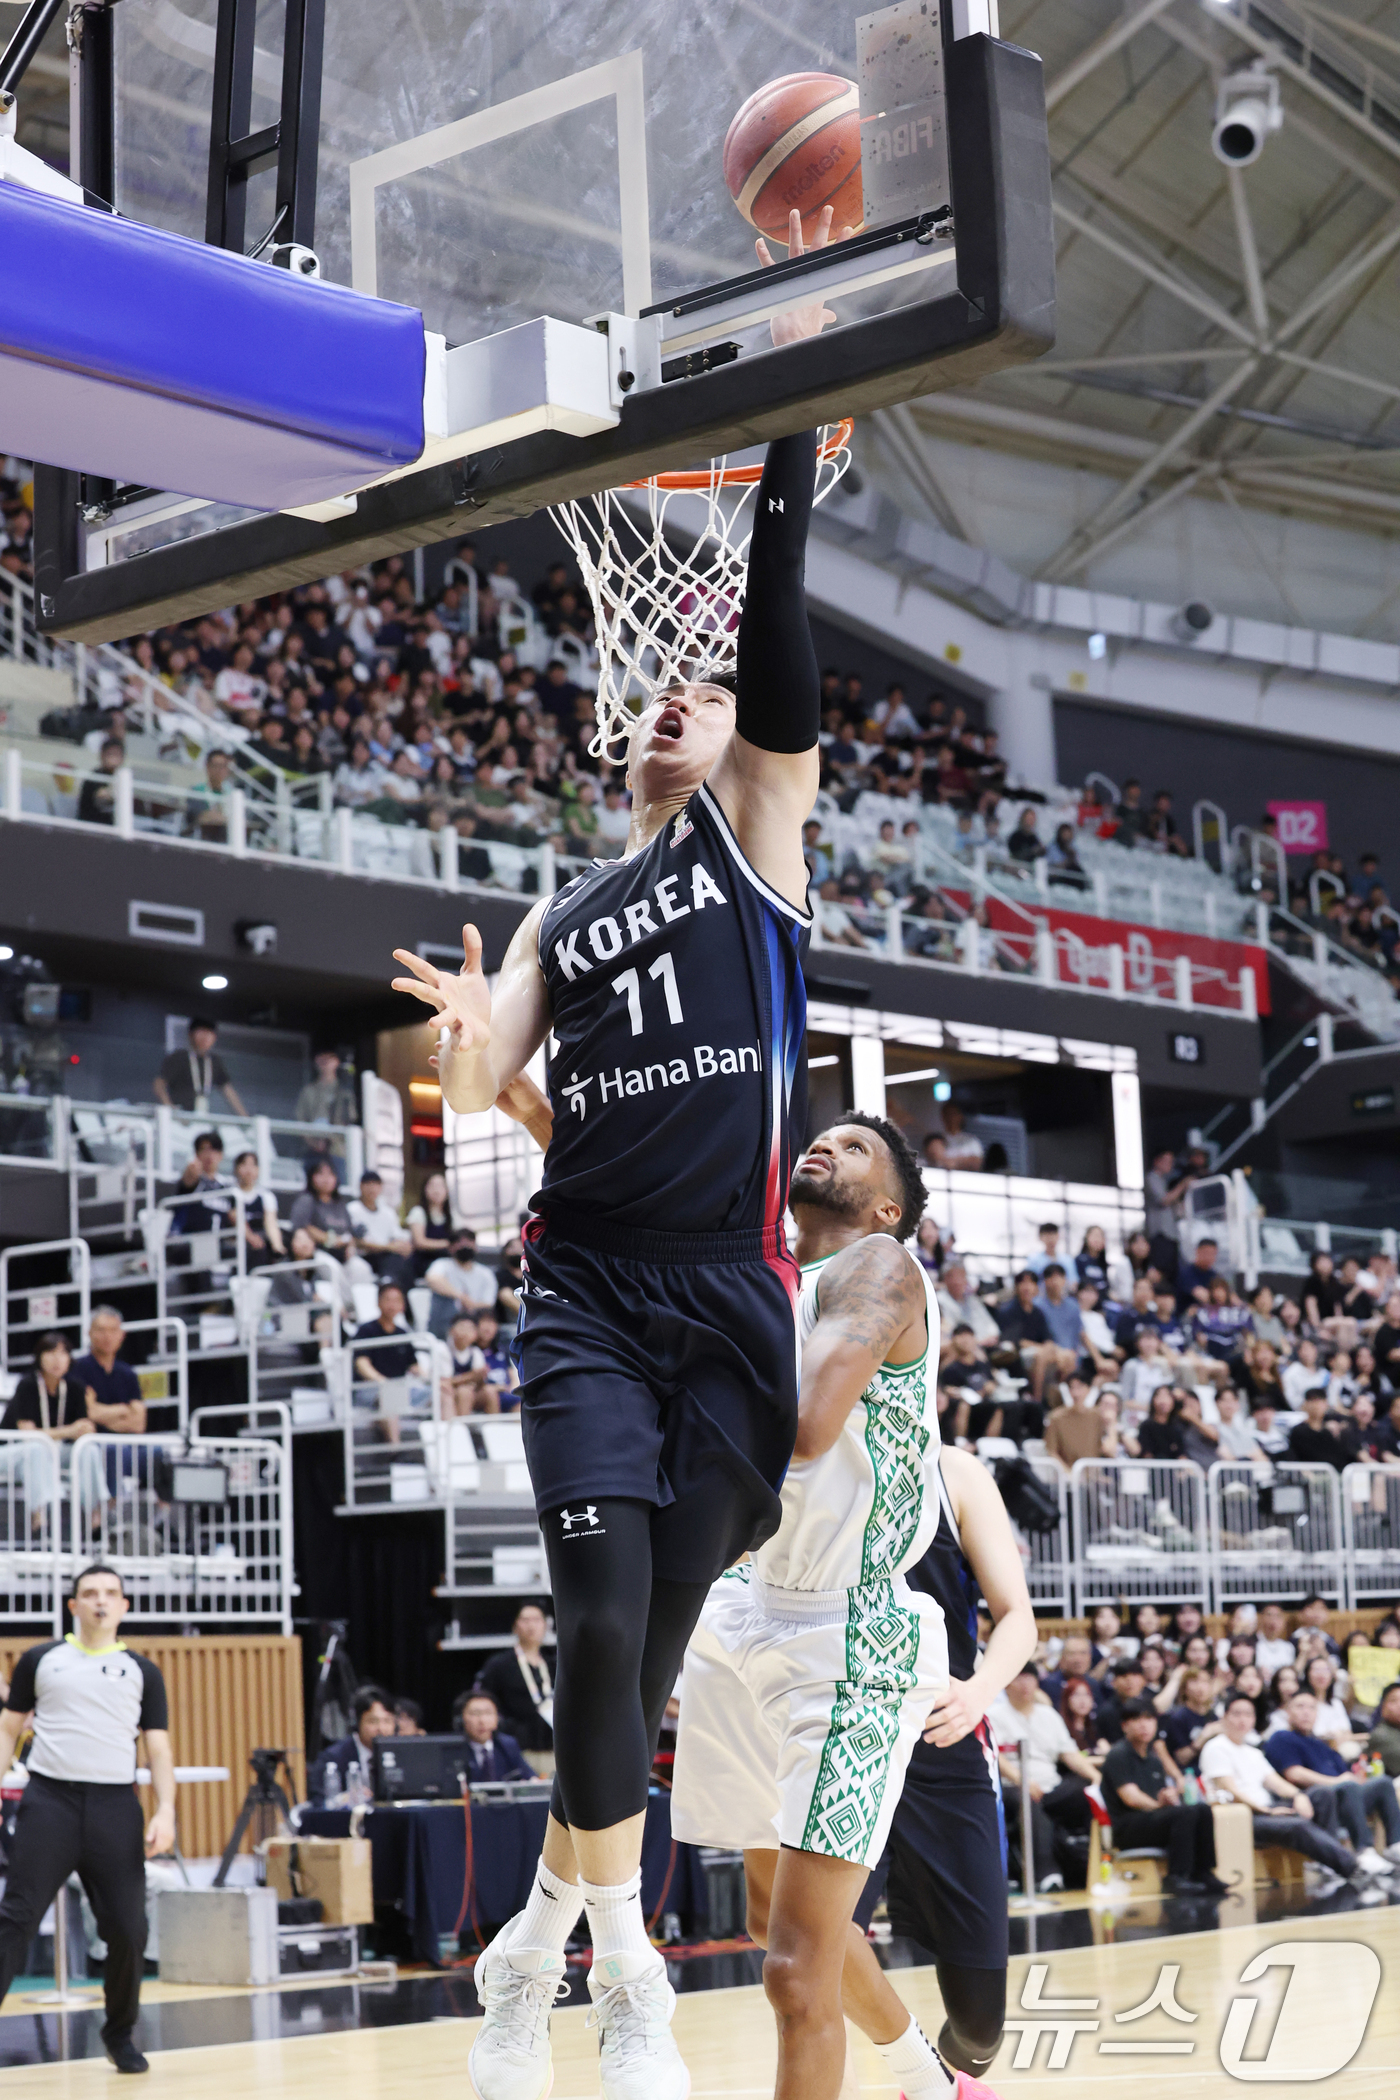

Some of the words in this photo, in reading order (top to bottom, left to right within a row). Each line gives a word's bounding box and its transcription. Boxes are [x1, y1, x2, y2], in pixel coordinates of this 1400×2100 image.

[782, 144, 846, 205] molten
[554, 863, 728, 982] KOREA
[611, 952, 684, 1036] 11
[599, 1058, 690, 1103] Hana
[562, 1532, 580, 1540] UNDER
[580, 1528, 606, 1537] ARMOUR
